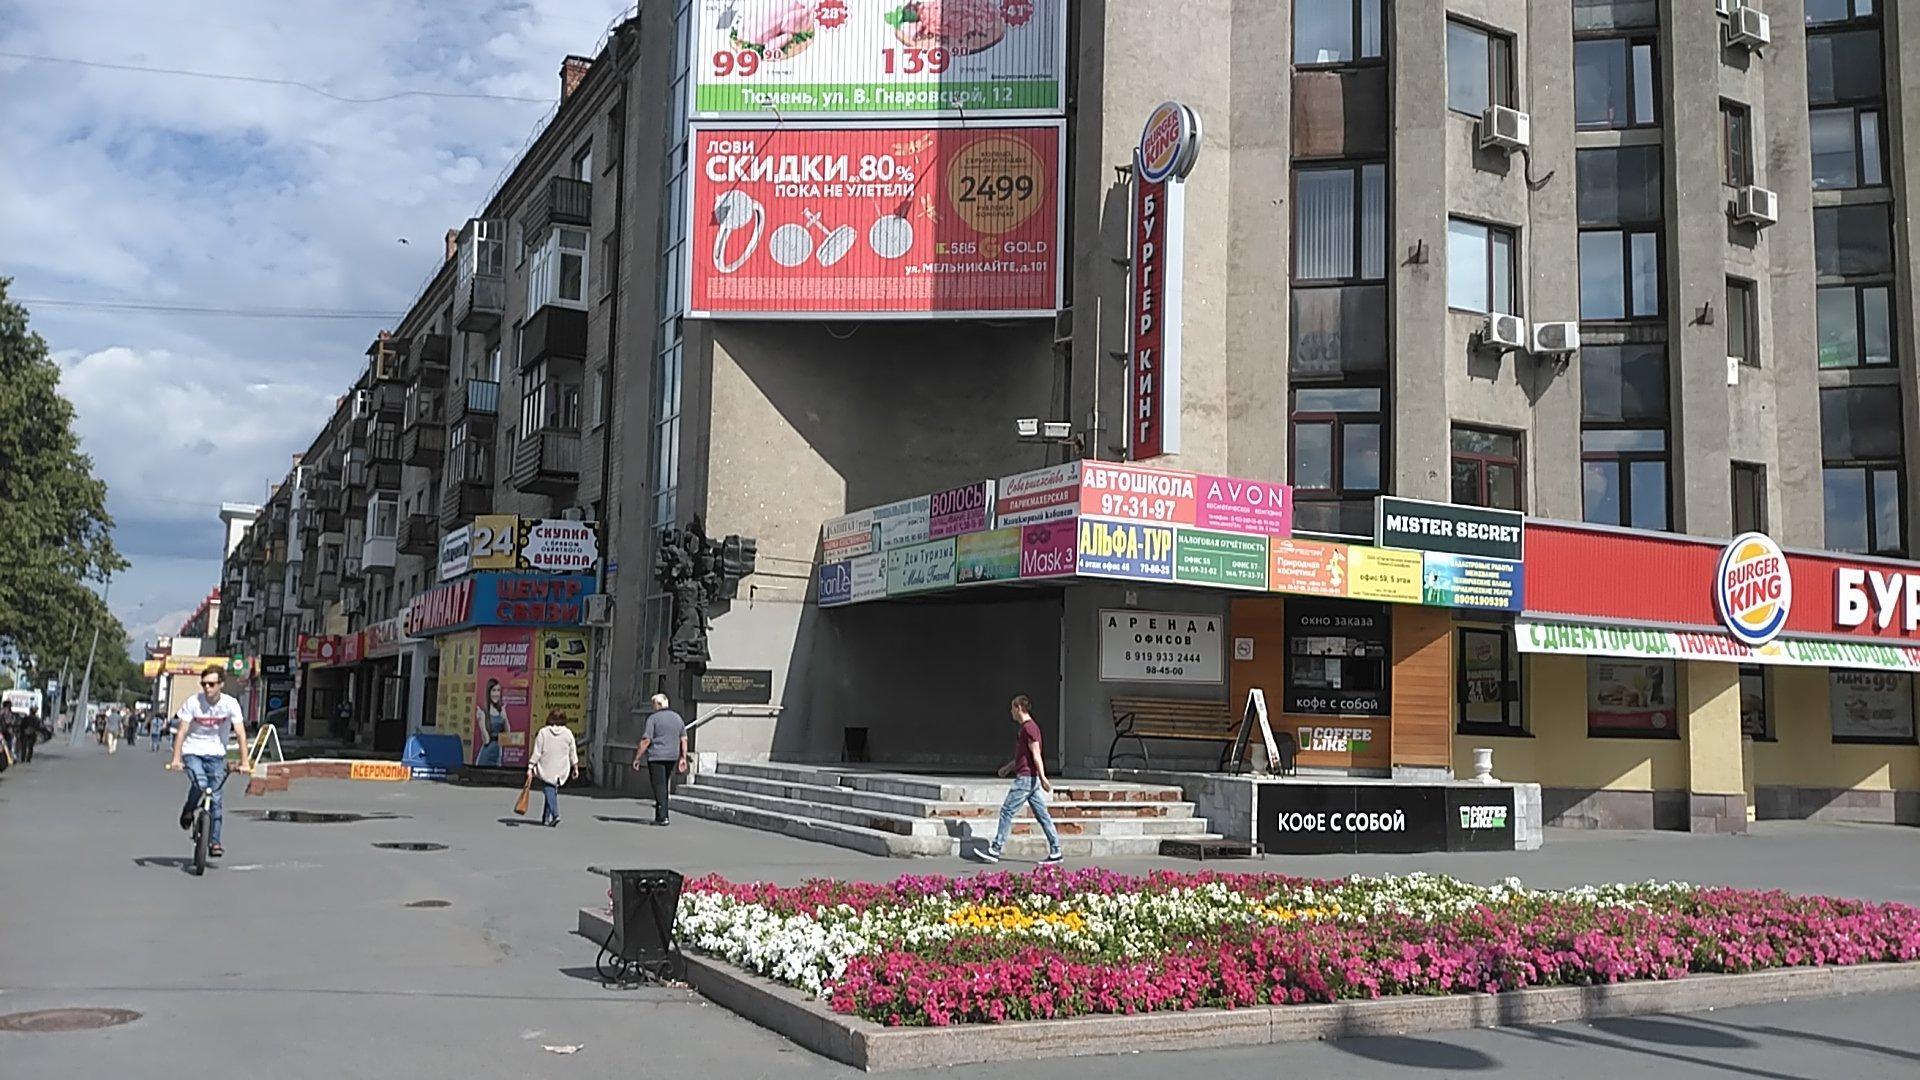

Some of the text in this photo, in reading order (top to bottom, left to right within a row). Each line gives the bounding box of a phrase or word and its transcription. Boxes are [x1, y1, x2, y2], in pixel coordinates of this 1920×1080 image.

[713, 51, 781, 76] 99 90
[882, 48, 950, 74] 139
[742, 87, 1012, 107] Тюмень, ул. В. Гнаровской, 12
[1145, 110, 1178, 154] BURGER
[706, 141, 754, 154] ЛОВИ
[1145, 121, 1179, 169] KING
[705, 155, 848, 183] СКИДКИ
[860, 154, 914, 182] 80%
[775, 183, 914, 198] ПОКА НЕ УЛЕТЕЛИ
[959, 175, 1033, 202] 2499
[951, 243, 976, 255] 585
[1004, 241, 1047, 253] GOLD
[1140, 194, 1156, 336] БУРГЕР
[1139, 348, 1152, 444] КИНГ
[1070, 464, 1076, 474] 3
[1083, 468, 1194, 499] АВТОШКОЛА
[1009, 490, 1069, 510] ПАРИКМАХЕРСКАЯ
[1207, 481, 1283, 508] AVON
[1101, 494, 1176, 520] 97-31-97
[536, 528, 589, 540] СКУПКА
[1386, 514, 1521, 543] MISTER SECRET
[474, 526, 514, 556] 24
[1079, 521, 1172, 561] АЛЬФА-ТУР
[1178, 535, 1220, 547] НАЛОГОВАЯ
[534, 553, 590, 566] ВЫКУПА
[920, 545, 954, 564] Туризма
[1023, 546, 1062, 574] Mask
[1065, 548, 1073, 562] 3
[1184, 556, 1202, 564] ОФИС
[1360, 574, 1378, 582] офис
[1728, 557, 1780, 588] BURGER
[497, 579, 582, 600] ЦЕНТР
[1728, 574, 1782, 615] KING
[497, 602, 580, 622] СВЯЗИ
[1301, 616, 1373, 626] окно заказа
[1108, 616, 1216, 633] АРЕНДА
[1134, 633, 1192, 646] ОФИСОВ
[1529, 624, 1542, 649] С
[481, 654, 528, 666] БЕСПЛАТНО!
[1125, 652, 1201, 663] 8 919 933 2444
[1146, 665, 1183, 676] 98-45-00
[1873, 674, 1898, 693] 99
[1296, 696, 1378, 710] кофе с собой
[1313, 727, 1372, 741] COFFEE
[1313, 739, 1348, 752] LIKE
[1278, 809, 1406, 832] КОФЕ С СОБОЙ
[1469, 806, 1508, 818] COFFEE
[1469, 816, 1493, 829] LIKE
